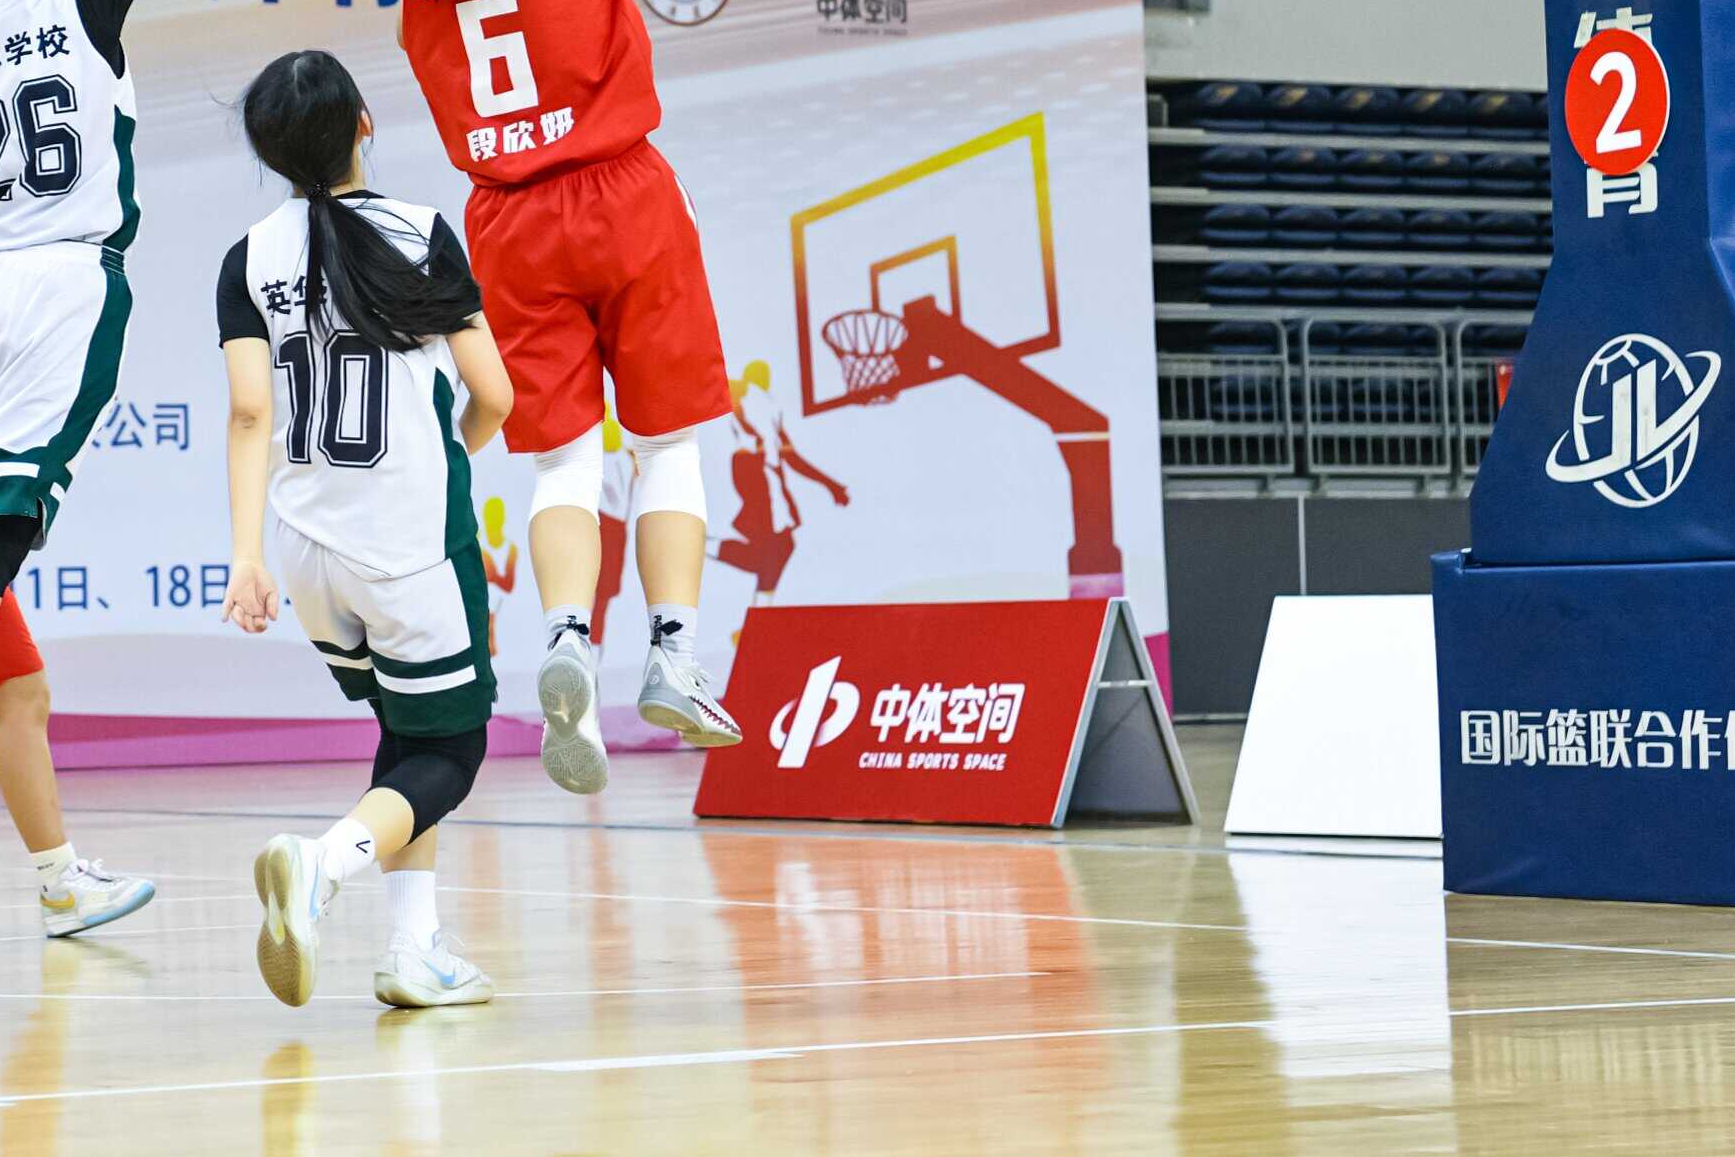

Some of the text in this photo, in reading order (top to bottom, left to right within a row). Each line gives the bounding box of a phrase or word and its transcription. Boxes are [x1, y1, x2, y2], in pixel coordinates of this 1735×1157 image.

[1589, 51, 1642, 154] 2
[274, 329, 389, 469] 10
[870, 683, 1026, 744] 中体空间
[1460, 708, 1735, 771] 国际篮联合作
[858, 752, 1007, 771] CHINA SPORTS SPACE
